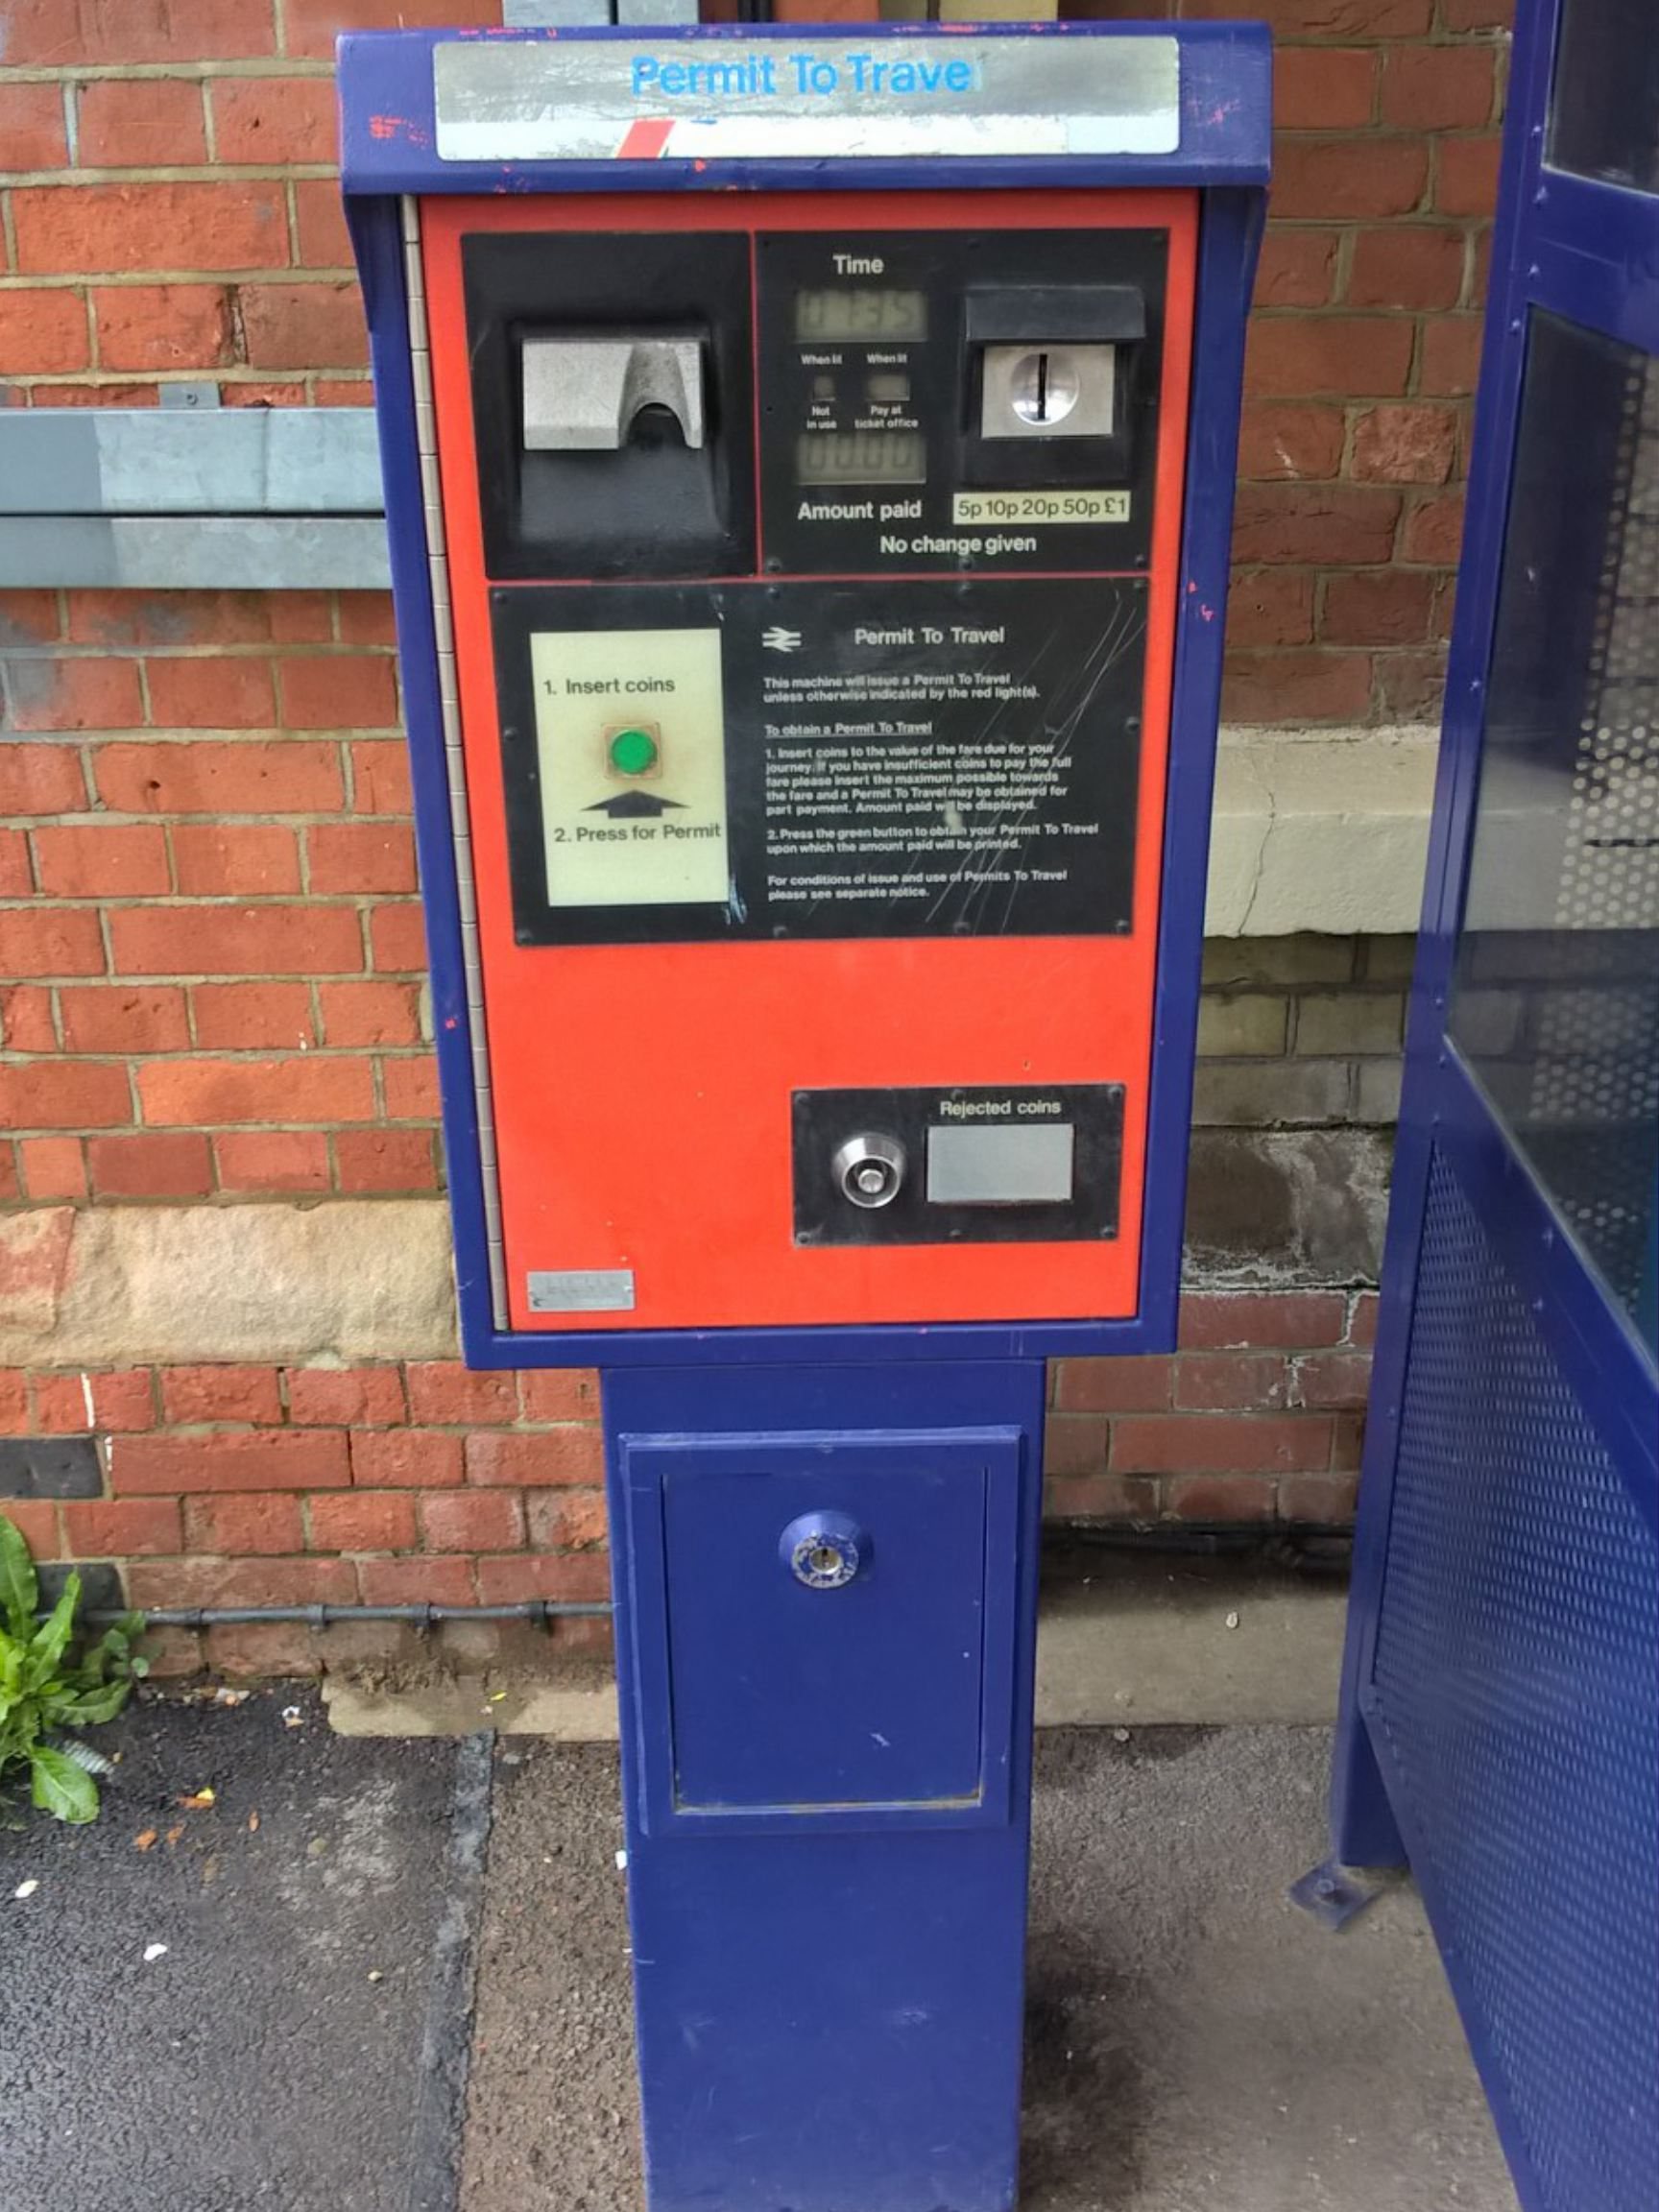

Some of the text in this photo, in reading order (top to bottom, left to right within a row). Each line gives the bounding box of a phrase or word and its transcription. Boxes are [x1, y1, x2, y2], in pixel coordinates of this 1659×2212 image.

[630, 55, 776, 95] Permit
[788, 54, 838, 95] To
[832, 254, 884, 275] Time
[801, 354, 830, 365] When
[867, 353, 896, 364] When
[811, 405, 830, 416] Not
[871, 405, 902, 417] Pay at
[806, 420, 837, 429] in use
[854, 418, 919, 428] ticket office
[798, 500, 923, 522] Amount paid
[959, 496, 1126, 517] 5p 10p 20p 50p £1
[880, 535, 1037, 556] No change given
[854, 627, 1005, 645] Permit To Travel
[543, 677, 676, 695] 1. Insert coins
[763, 678, 789, 688] This
[792, 677, 842, 687] machine
[867, 676, 900, 686] issue
[914, 675, 954, 685] Permit
[958, 674, 972, 685] To
[974, 673, 1011, 685] Travel
[763, 691, 804, 703] unless
[806, 689, 867, 702] otherwise
[870, 688, 926, 700] indicated
[929, 688, 945, 701] by
[948, 687, 968, 698] the
[972, 687, 991, 698] red
[766, 725, 780, 735] To
[782, 724, 821, 735] obtain
[835, 723, 875, 734] Permit
[879, 722, 893, 733] To
[896, 722, 932, 733] Travel
[766, 743, 1054, 758] 1. Insert coins to the value of the fare due for your
[829, 761, 852, 773] you
[854, 760, 881, 770] have
[884, 759, 951, 770] insufficient
[954, 758, 987, 769] coins
[990, 758, 1001, 768] to
[1004, 758, 1026, 770] pay
[1029, 757, 1049, 767] the
[1052, 757, 1071, 767] full
[766, 772, 1058, 787] fare please insert the maximum possible towards
[767, 790, 786, 802] the
[789, 790, 813, 801] fare
[816, 789, 838, 800] and
[852, 787, 891, 799] Permit
[896, 787, 908, 798] To
[912, 786, 947, 798] Travel
[949, 787, 974, 799] may
[976, 786, 990, 797] be
[994, 785, 1046, 797] obtained
[1050, 785, 1068, 796] for
[767, 805, 792, 816] part
[855, 802, 902, 813] Amount
[905, 802, 931, 813] paid
[957, 800, 973, 811] be
[554, 823, 721, 842] 2. Press for Permit
[767, 830, 779, 840] 2.
[780, 829, 813, 839] Press
[816, 829, 835, 838] the
[837, 829, 872, 840] green
[874, 827, 913, 838] button
[915, 827, 927, 837] to
[970, 826, 995, 837] your
[1000, 824, 1041, 834] Permit
[1045, 824, 1058, 834] To
[1062, 823, 1098, 833] Travel
[767, 845, 797, 854] upon
[800, 842, 834, 853] which
[836, 842, 856, 852] the
[858, 841, 903, 852] amount
[907, 840, 932, 852] paid
[935, 839, 954, 850] will
[957, 839, 972, 849] be
[768, 870, 1068, 885] For conditions of issue and use of Permits To Travel
[768, 890, 806, 902] please
[810, 890, 831, 900] see
[835, 888, 887, 900] separate
[940, 1099, 1062, 1118] Rejected coins
